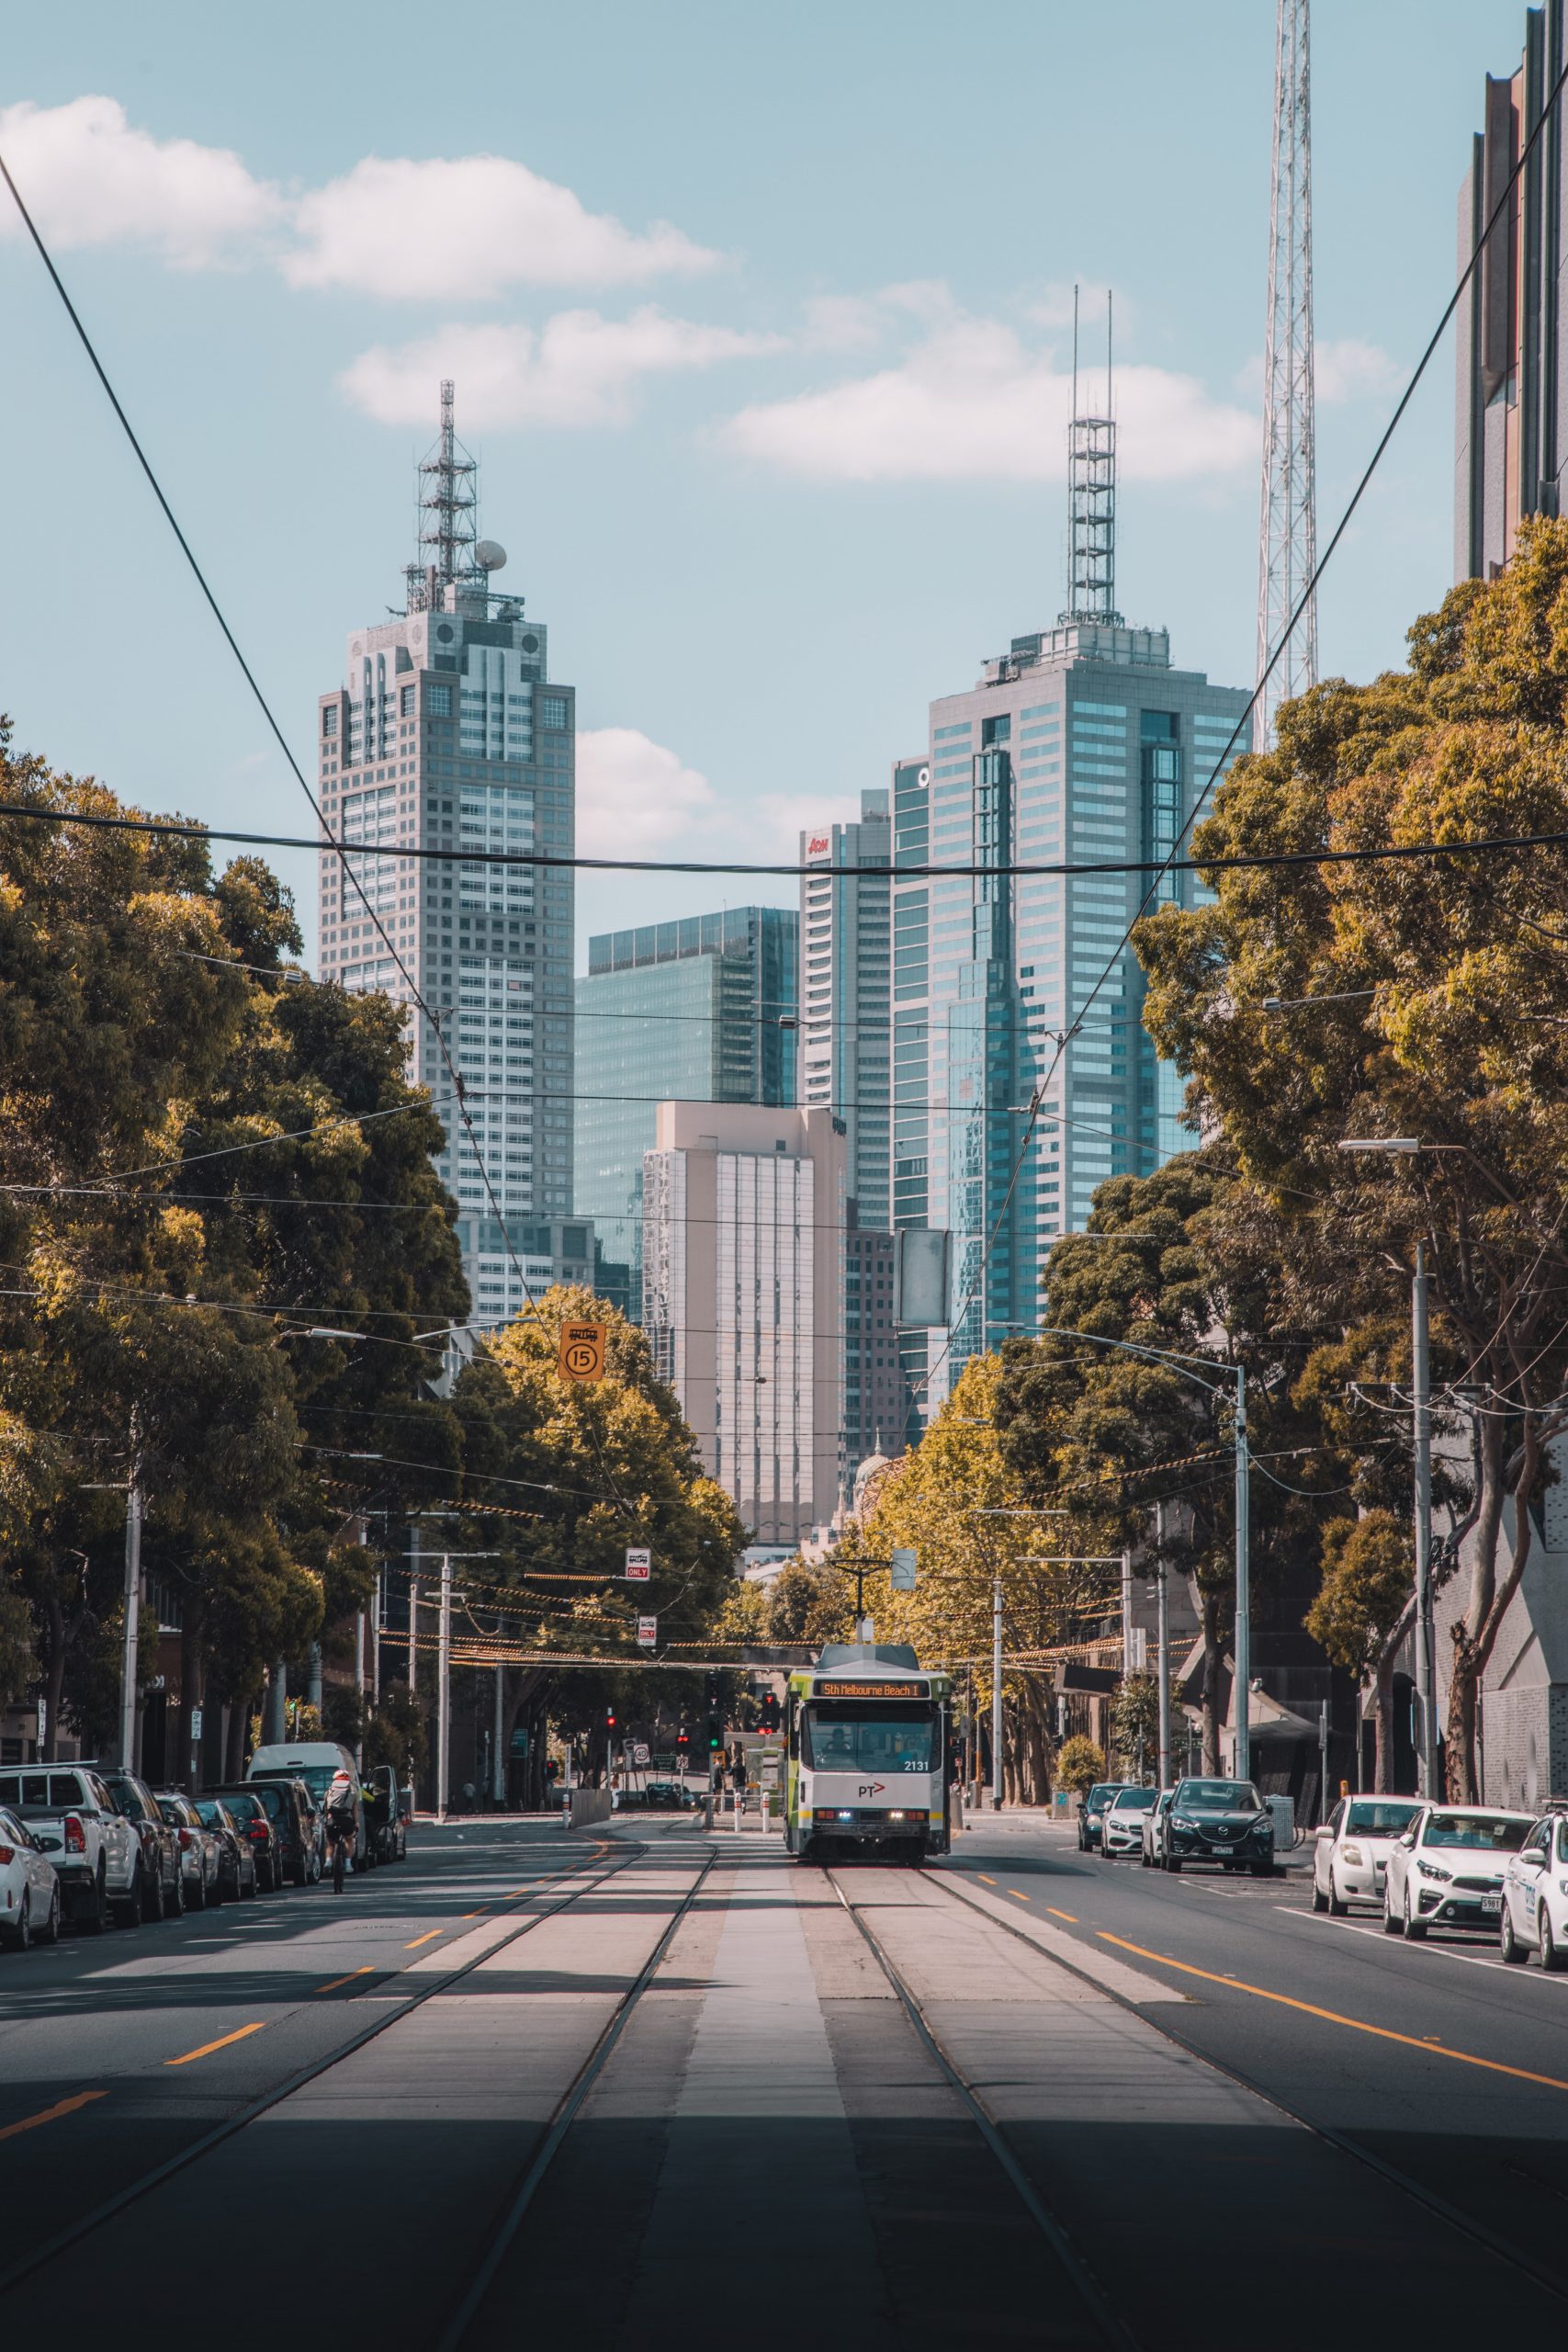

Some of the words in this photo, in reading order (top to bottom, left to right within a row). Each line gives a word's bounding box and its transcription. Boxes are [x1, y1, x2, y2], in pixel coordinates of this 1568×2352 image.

[573, 1351, 590, 1366] 15
[628, 1568, 648, 1577] ONLY
[824, 1684, 840, 1695] Sth
[840, 1684, 882, 1695] Melbourne
[884, 1685, 910, 1696] Beach
[913, 1685, 919, 1696] 1
[904, 1760, 929, 1771] 2131
